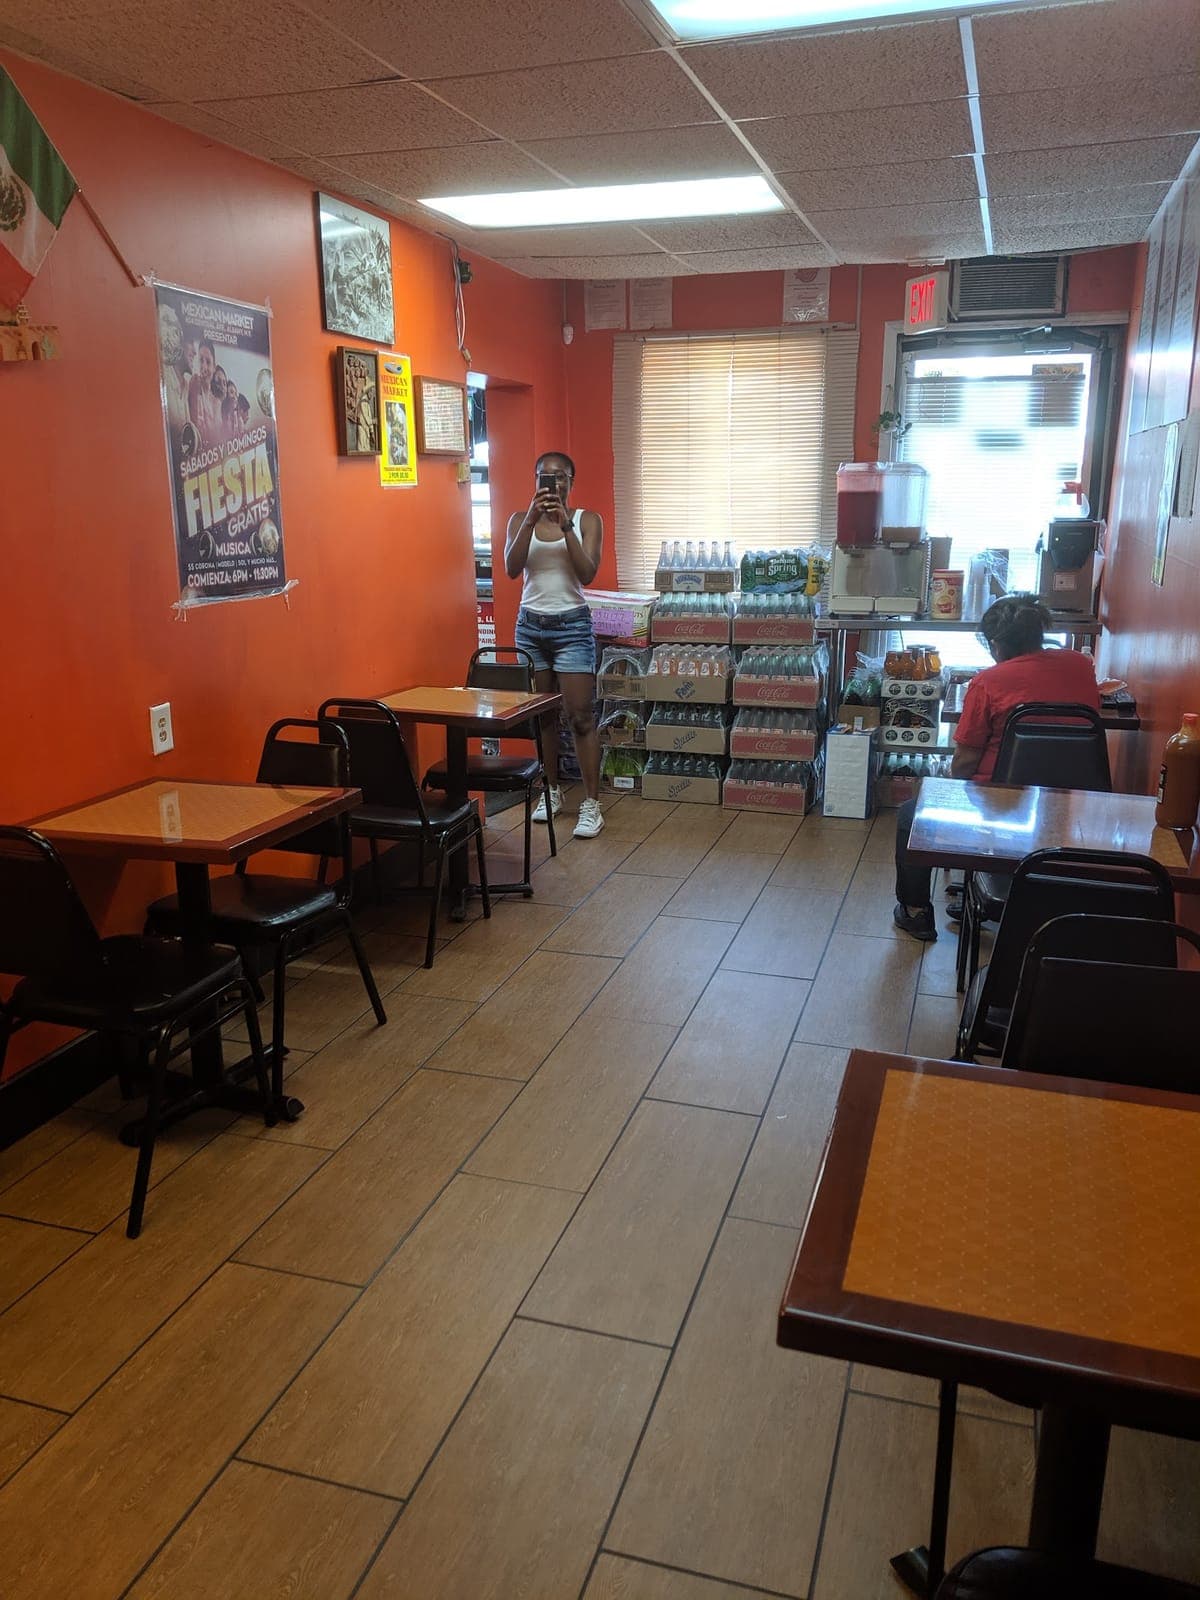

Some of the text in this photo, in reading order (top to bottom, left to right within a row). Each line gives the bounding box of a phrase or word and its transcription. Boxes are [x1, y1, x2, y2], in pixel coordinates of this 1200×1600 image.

[181, 301, 220, 321] MEXICAN
[221, 311, 254, 330] MARKET
[910, 279, 936, 324] EXIT
[180, 426, 267, 477] SABADOS Y DOMINGOS
[183, 442, 273, 537] FIESTA
[228, 500, 269, 537] GRATIS
[215, 541, 252, 557] MUSICA
[232, 569, 248, 583] 6PM
[253, 566, 279, 580] 11:30PM
[768, 564, 798, 576] Spring
